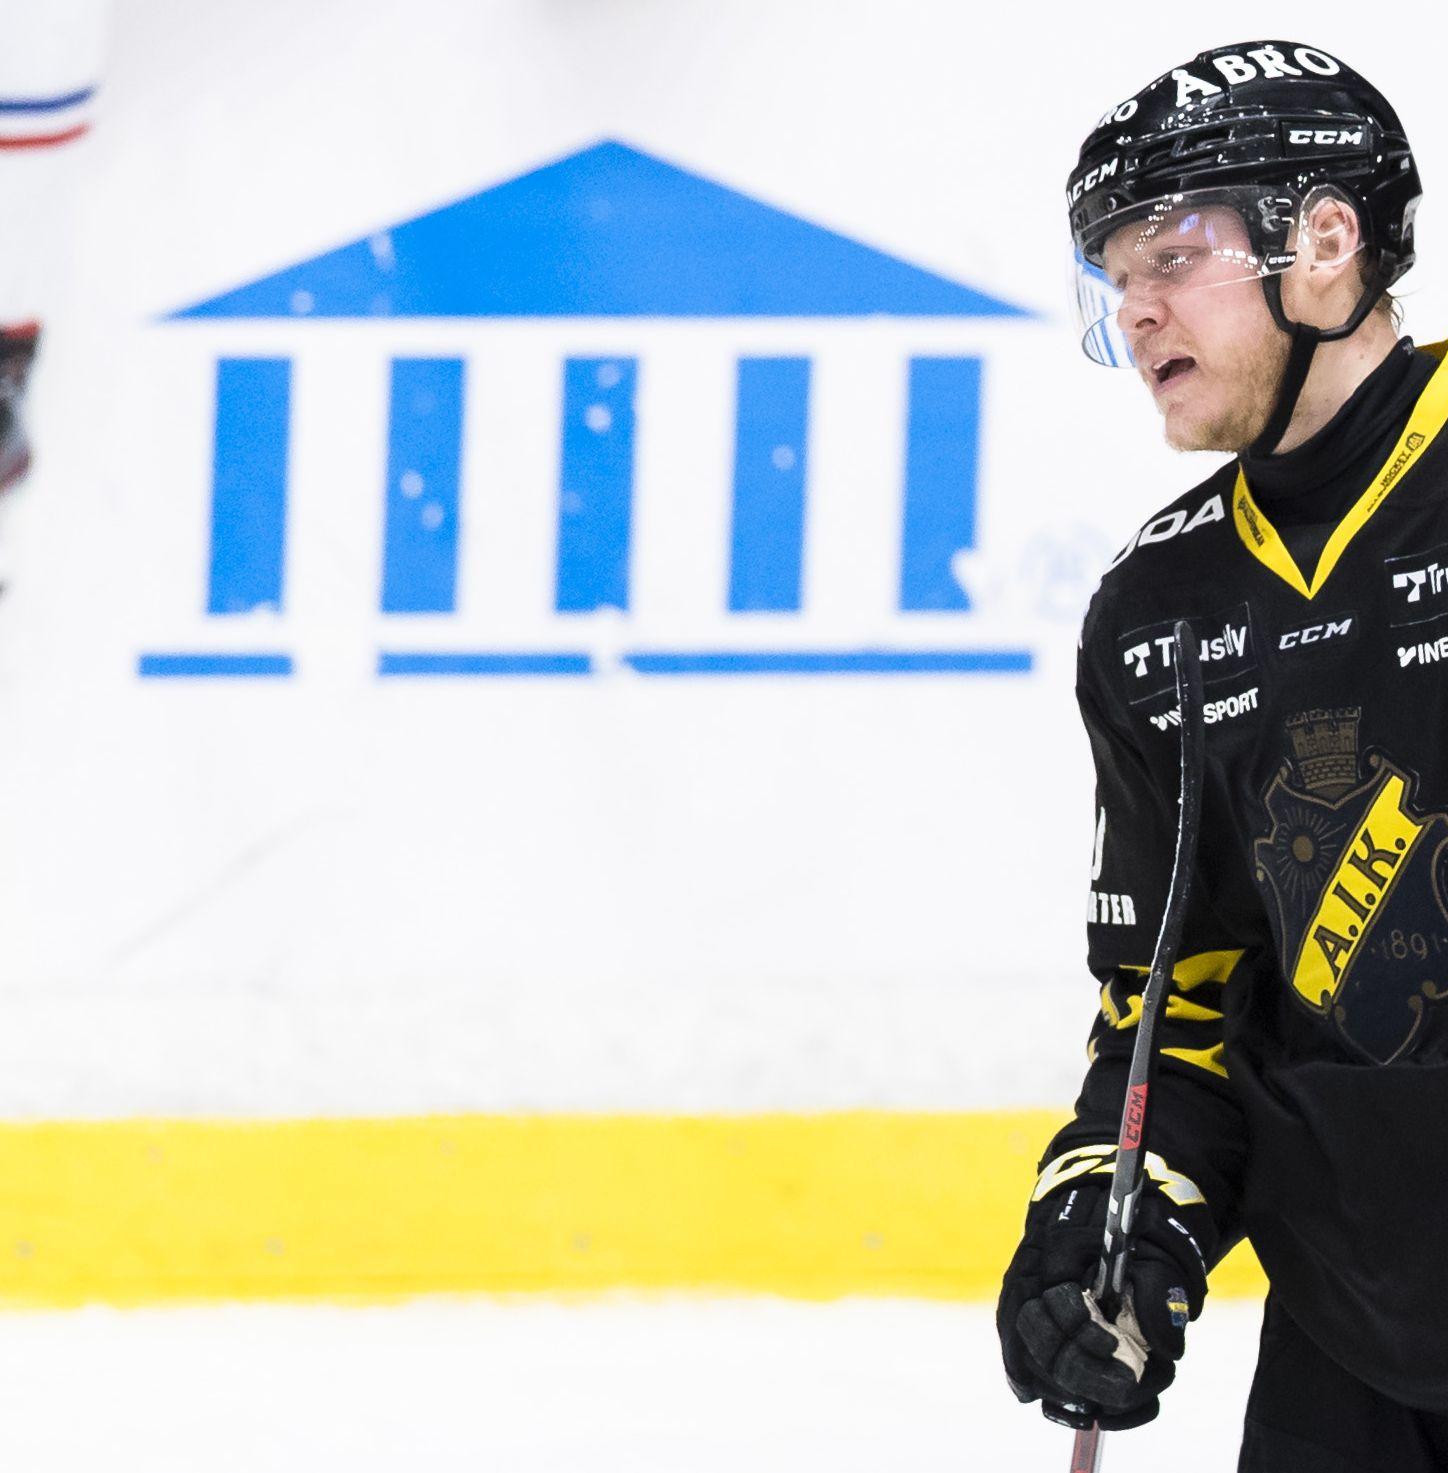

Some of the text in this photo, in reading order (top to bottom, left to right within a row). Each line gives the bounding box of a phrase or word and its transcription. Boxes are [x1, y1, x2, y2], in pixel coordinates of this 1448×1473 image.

[1288, 131, 1363, 145] CCM
[1072, 157, 1119, 202] CCM
[1278, 618, 1352, 650] CCM
